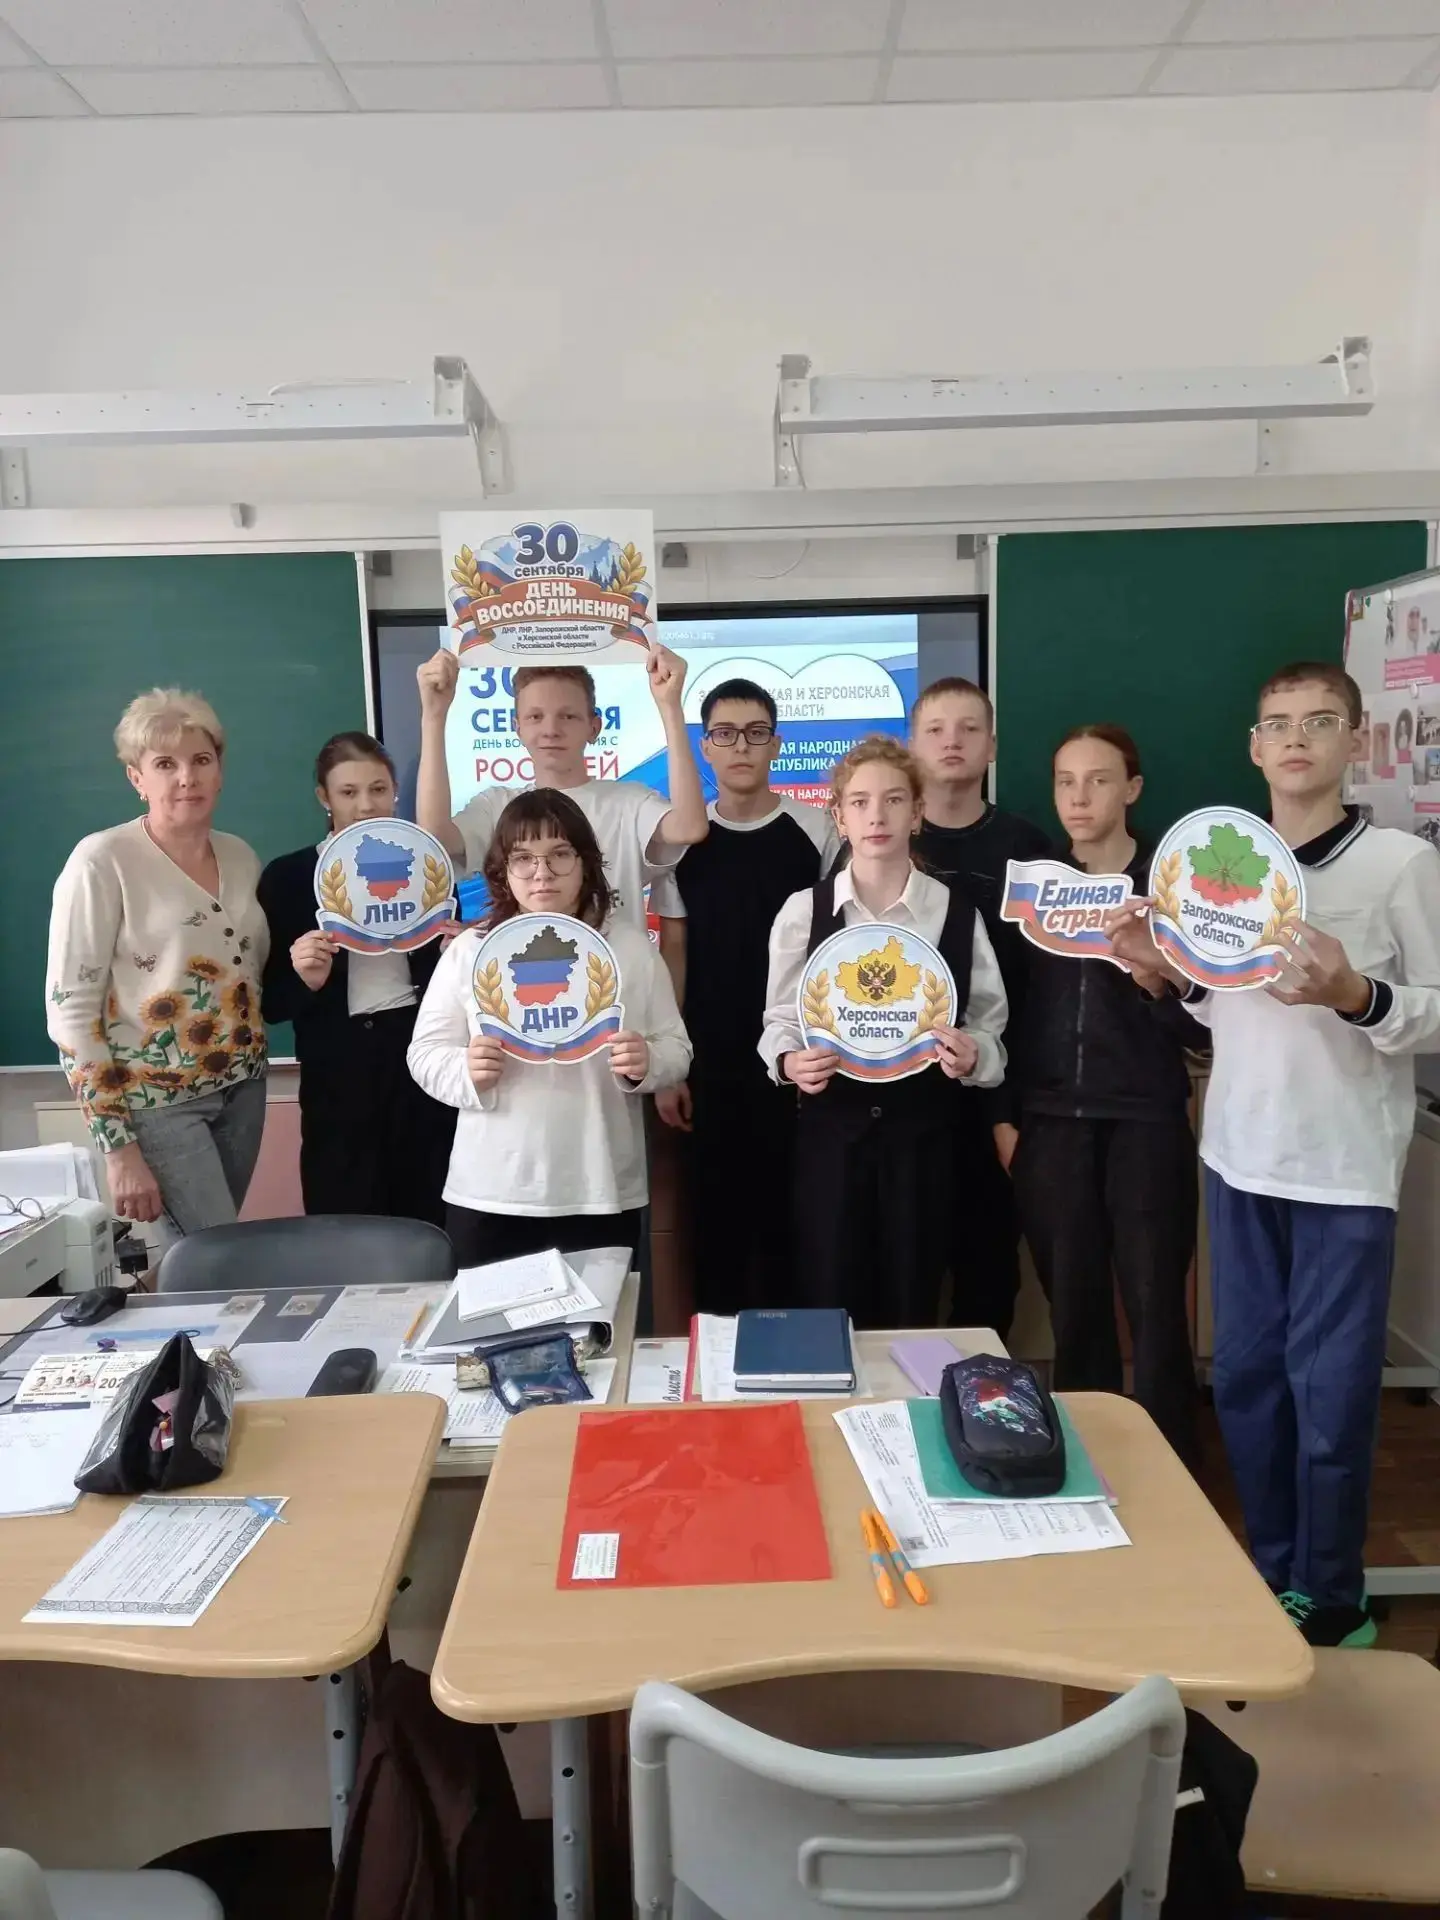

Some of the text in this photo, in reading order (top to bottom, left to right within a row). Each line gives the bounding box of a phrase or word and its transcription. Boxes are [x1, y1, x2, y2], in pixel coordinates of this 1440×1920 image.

[514, 523, 579, 564] 30
[514, 564, 584, 577] сентября
[526, 582, 577, 599] ДЕНЬ
[477, 598, 629, 625] ВОССОЕДИНЕНИЯ
[535, 625, 579, 634] Запорожской
[580, 624, 605, 632] области
[517, 641, 555, 650] Российской
[556, 640, 597, 649] Федерацией
[523, 634, 561, 643] Херсонской
[796, 688, 805, 700] И
[809, 685, 890, 700] ХЕРСОНСКАЯ
[777, 704, 824, 717] БЛАСТИ
[473, 739, 501, 750] ДЕНЬ
[770, 758, 836, 772] СПУБЛИКА
[798, 789, 833, 800] НАРОД
[1039, 879, 1125, 908] Единая
[363, 902, 416, 925] ЛНР
[1047, 909, 1112, 933] стра
[1182, 900, 1264, 935] Запорожская
[1193, 923, 1245, 948] область
[521, 1006, 579, 1033] ДНР
[837, 1007, 917, 1024] Херсонская
[849, 1024, 904, 1039] область
